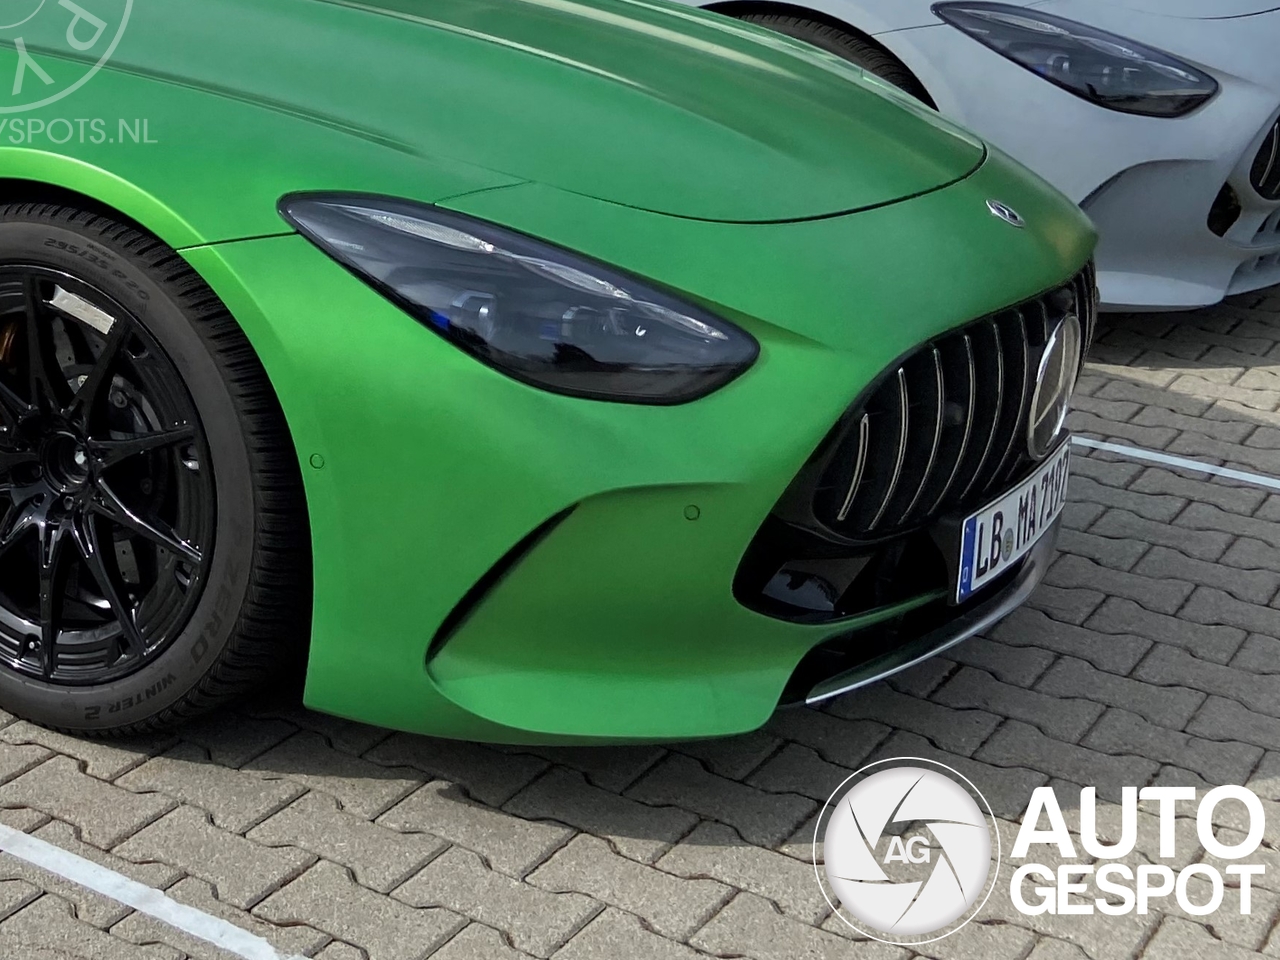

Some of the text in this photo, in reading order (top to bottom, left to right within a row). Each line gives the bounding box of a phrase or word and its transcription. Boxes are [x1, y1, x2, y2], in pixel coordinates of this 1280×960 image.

[975, 510, 1005, 580] LB
[1016, 483, 1038, 551] MA
[108, 672, 178, 715] WINTER
